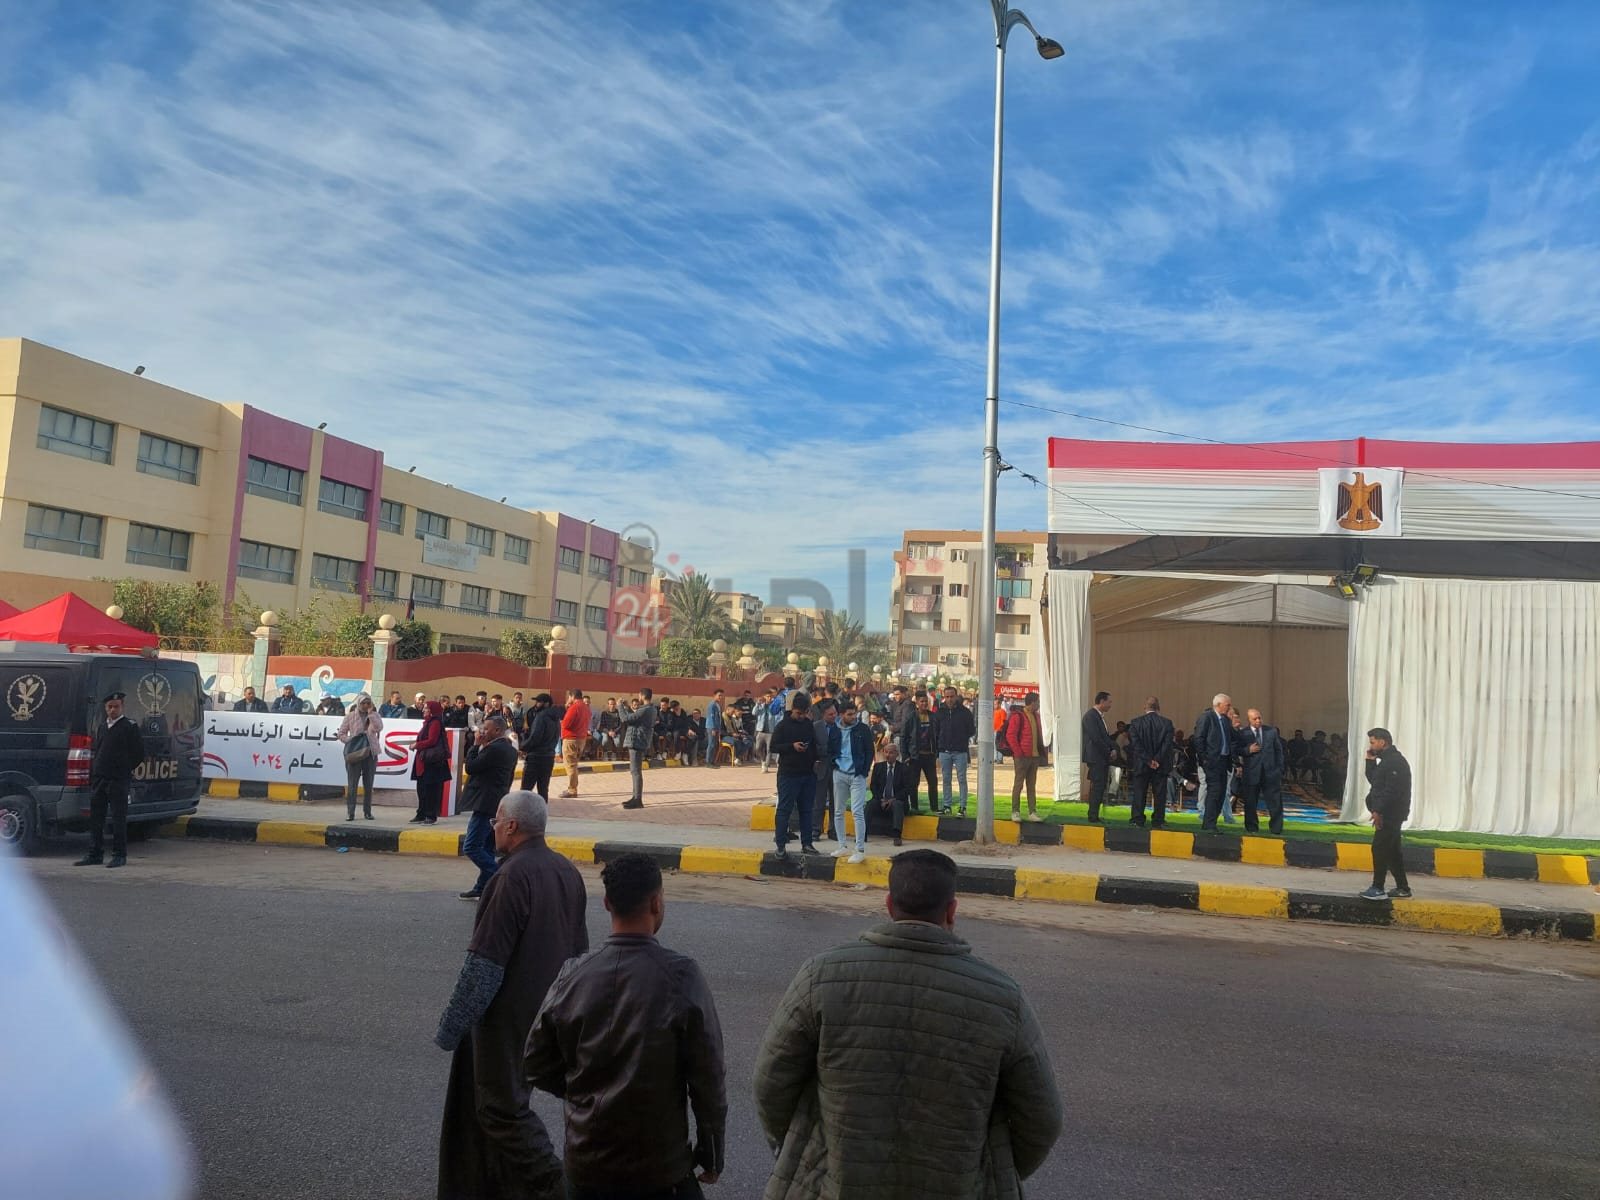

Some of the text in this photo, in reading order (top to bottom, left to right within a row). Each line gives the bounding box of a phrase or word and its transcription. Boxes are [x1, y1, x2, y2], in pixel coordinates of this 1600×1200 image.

[207, 719, 341, 746] خابات الرئاسية
[131, 760, 178, 780] OLICE
[252, 752, 323, 775] عام ٢٠٢٤
